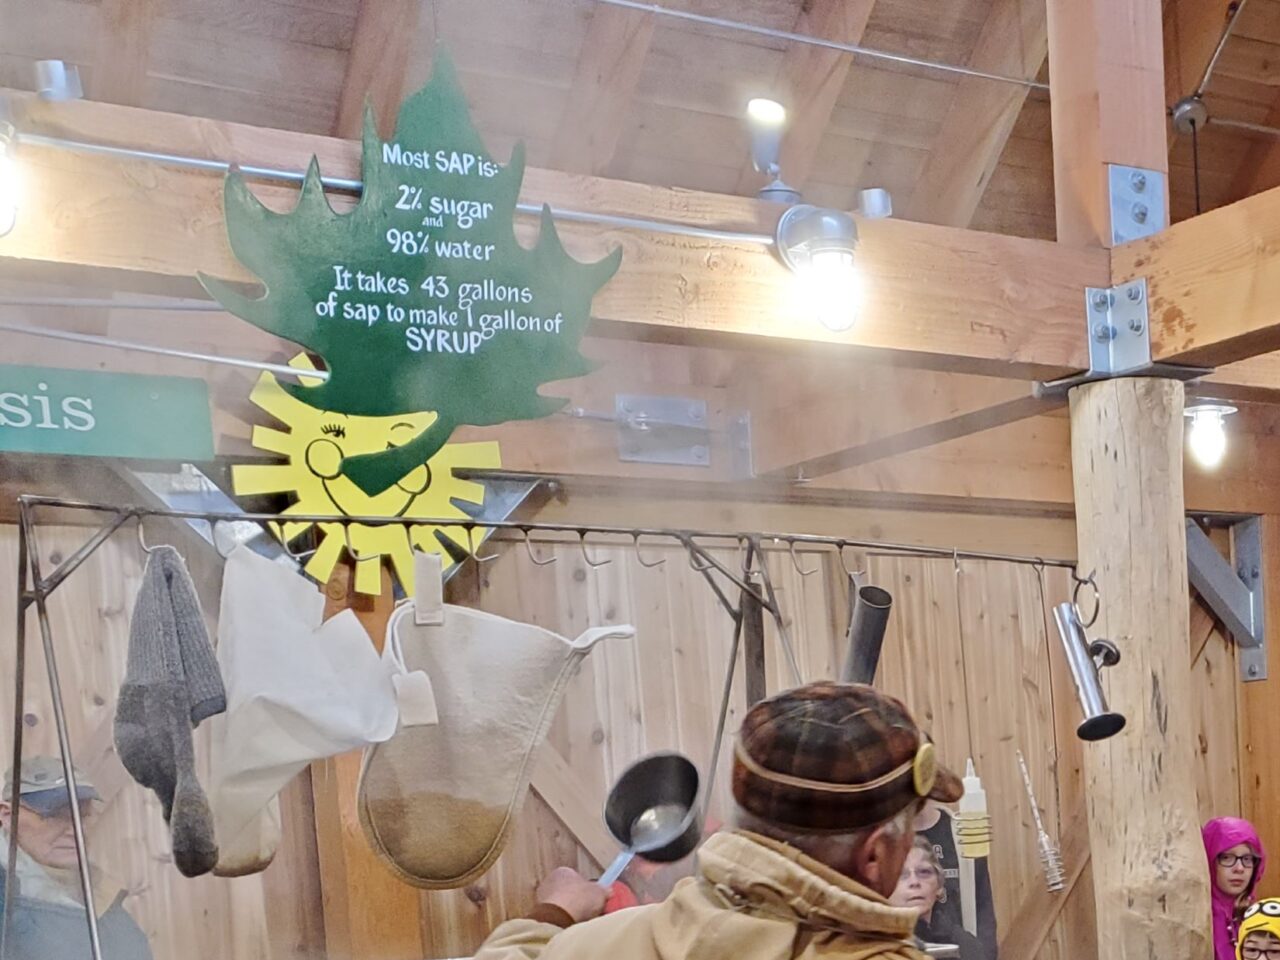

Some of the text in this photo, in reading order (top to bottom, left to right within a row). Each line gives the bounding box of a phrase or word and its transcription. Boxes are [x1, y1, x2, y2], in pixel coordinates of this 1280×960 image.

[383, 143, 498, 177] Most SAP is:
[395, 184, 493, 229] 2% sugar
[422, 215, 443, 227] and
[387, 228, 495, 260] 98% water
[333, 265, 533, 310] It takes 43 gallons
[316, 291, 338, 317] of
[343, 302, 380, 327] sap
[386, 302, 405, 322] to
[409, 305, 458, 326] make
[479, 309, 540, 340] gallon
[544, 312, 563, 333] of
[405, 326, 482, 354] SYRUP
